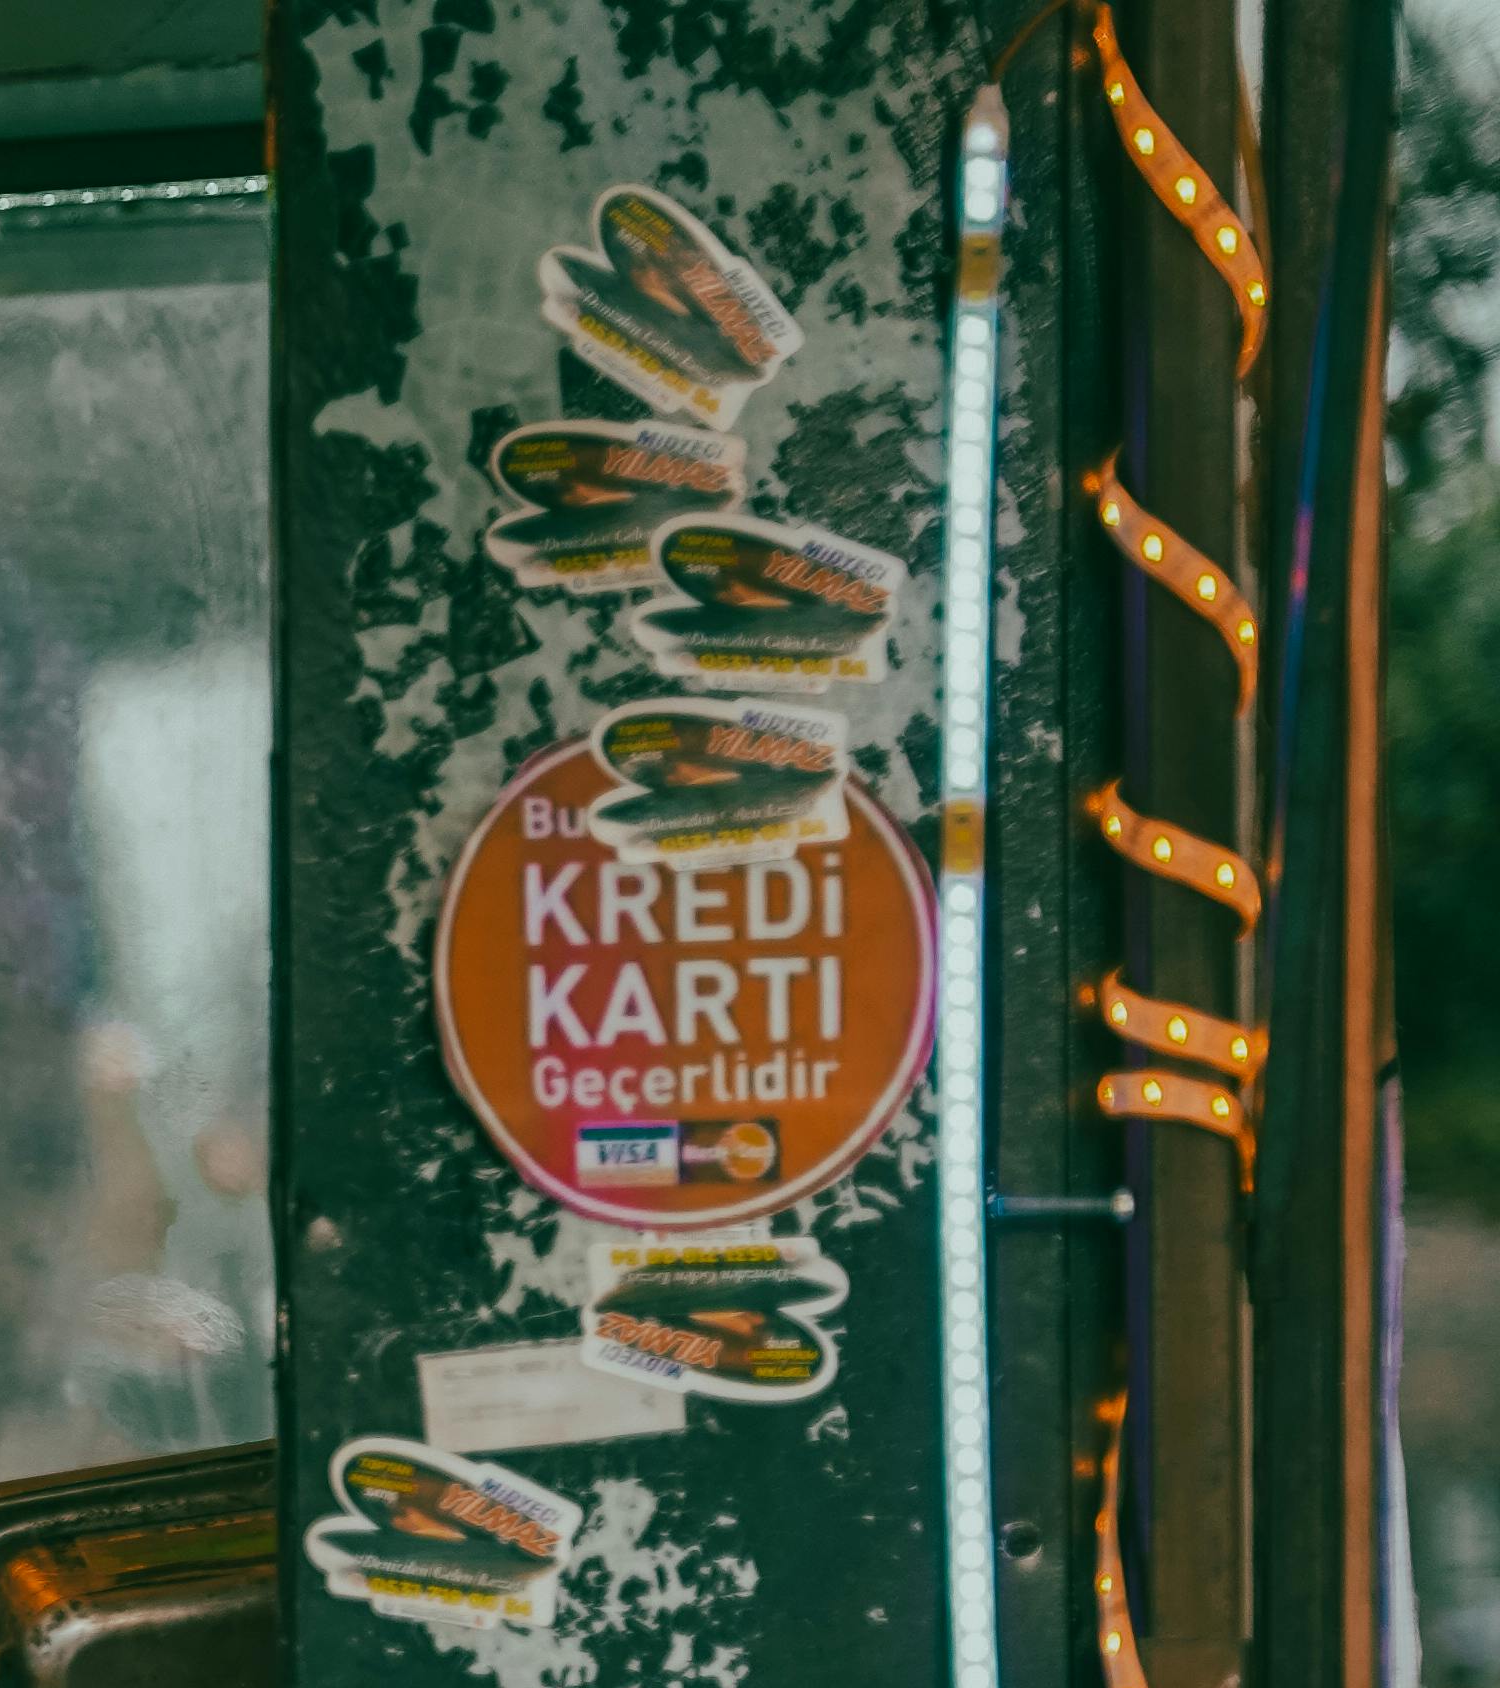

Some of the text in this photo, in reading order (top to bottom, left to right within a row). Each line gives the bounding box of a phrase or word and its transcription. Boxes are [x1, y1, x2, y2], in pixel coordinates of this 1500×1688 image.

[603, 447, 730, 492] YILMAZ
[763, 550, 892, 614] YILMAZ
[705, 725, 835, 772] YILMAZ
[527, 956, 843, 1049] KARTI
[532, 1051, 840, 1113] Geçerlidir
[598, 1141, 659, 1165] VISA
[596, 1312, 724, 1369] YILMAZ
[438, 1484, 562, 1557] YILMAZ
